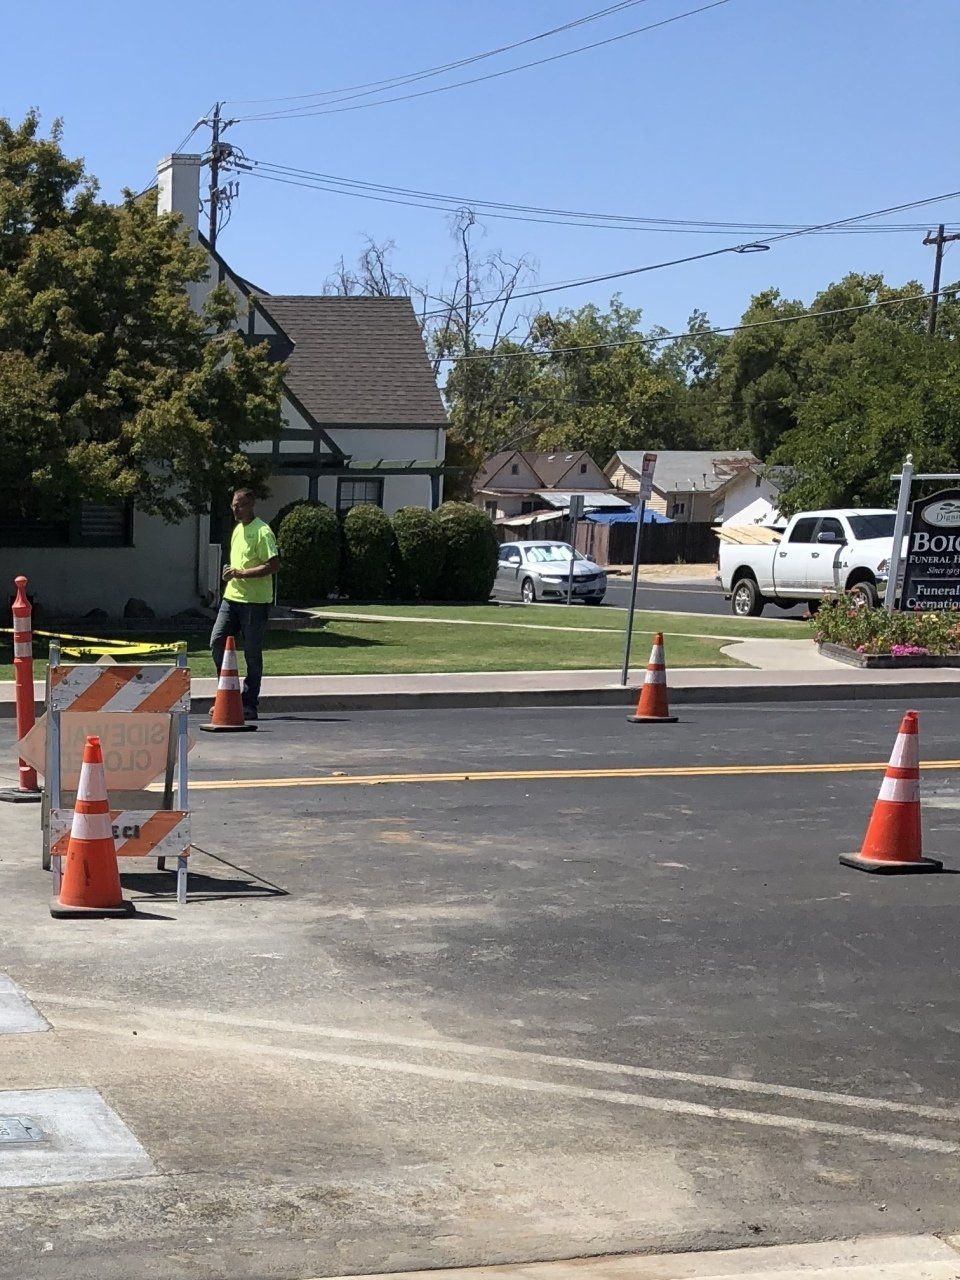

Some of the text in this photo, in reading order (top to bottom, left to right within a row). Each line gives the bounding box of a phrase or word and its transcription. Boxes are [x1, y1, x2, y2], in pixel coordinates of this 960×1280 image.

[936, 512, 960, 522] Digni
[908, 555, 951, 564] FUNERAL
[927, 566, 945, 574] Since
[916, 584, 960, 596] Funeral
[906, 597, 960, 609] Crematio
